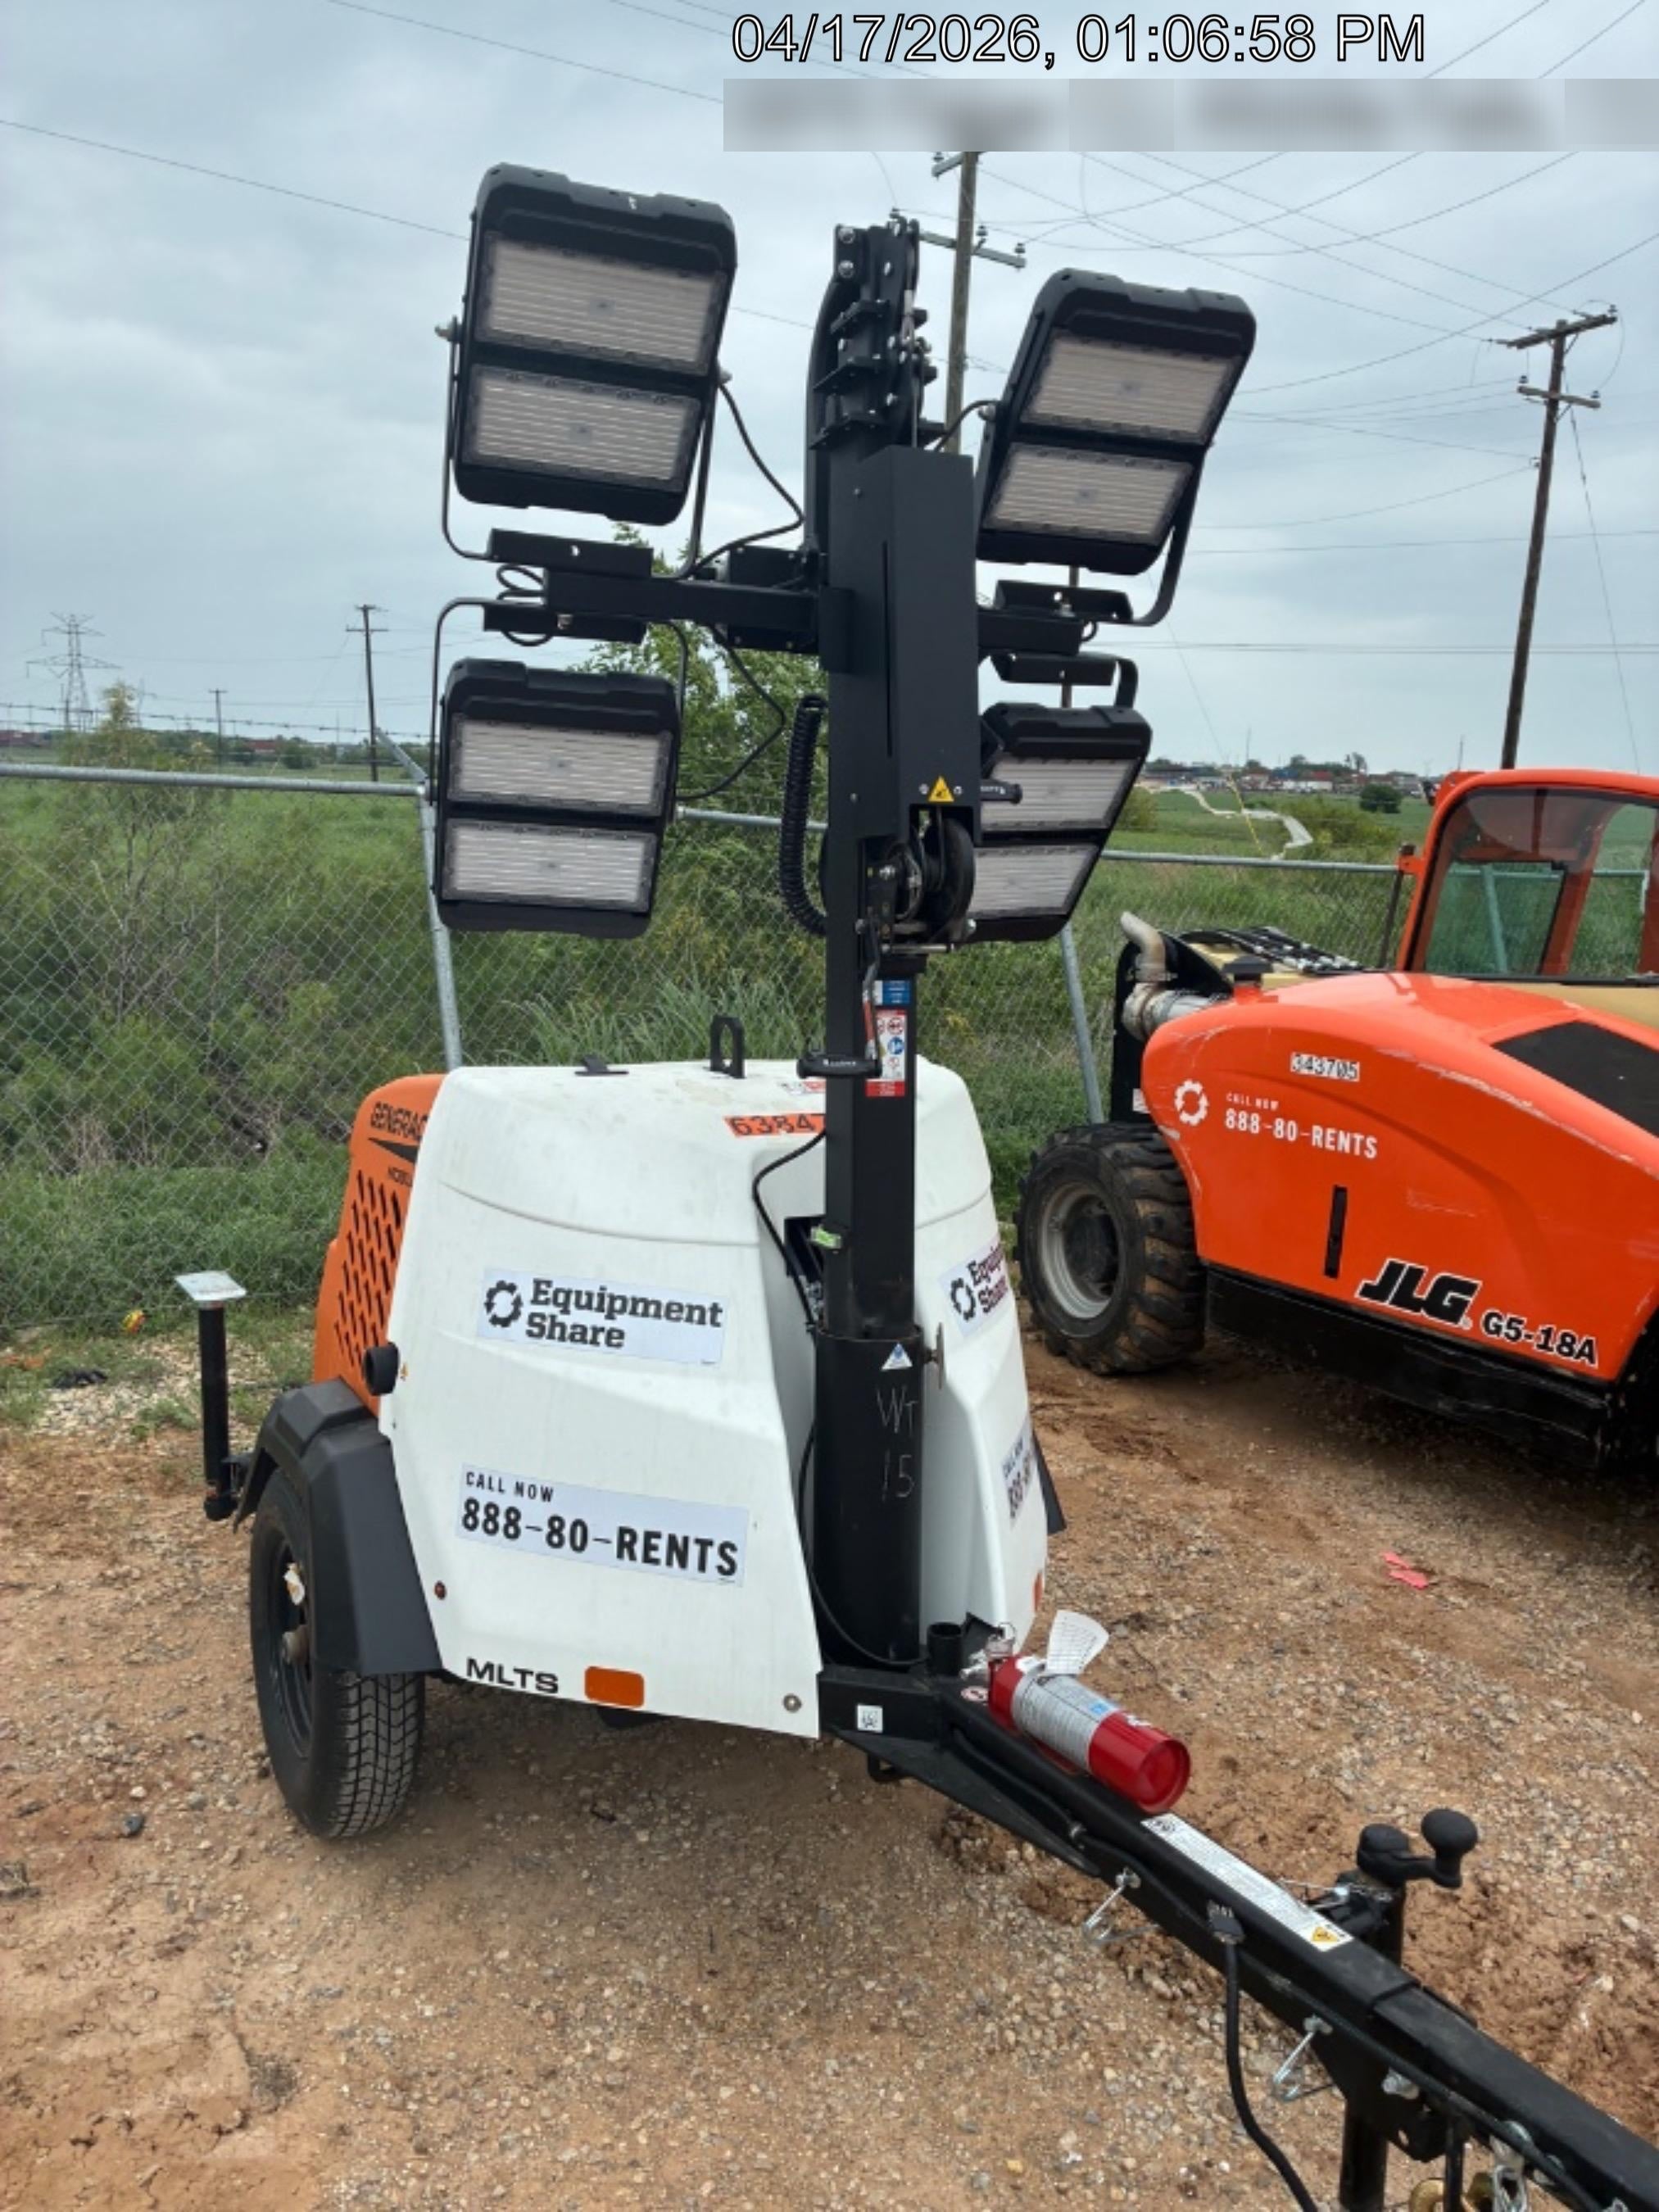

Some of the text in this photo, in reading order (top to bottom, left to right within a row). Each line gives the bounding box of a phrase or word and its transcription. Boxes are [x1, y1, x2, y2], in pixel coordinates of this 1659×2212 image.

[1225, 1107, 1378, 1159] 888-80-RENTS
[530, 1277, 723, 1327] Equipment
[1355, 1258, 1598, 1368] JLG G5-18A
[525, 1312, 625, 1349] Share
[465, 1471, 555, 1503] CALL NOW
[461, 1497, 738, 1576] 888-80-RENTS
[466, 1657, 559, 1693] MLTS
